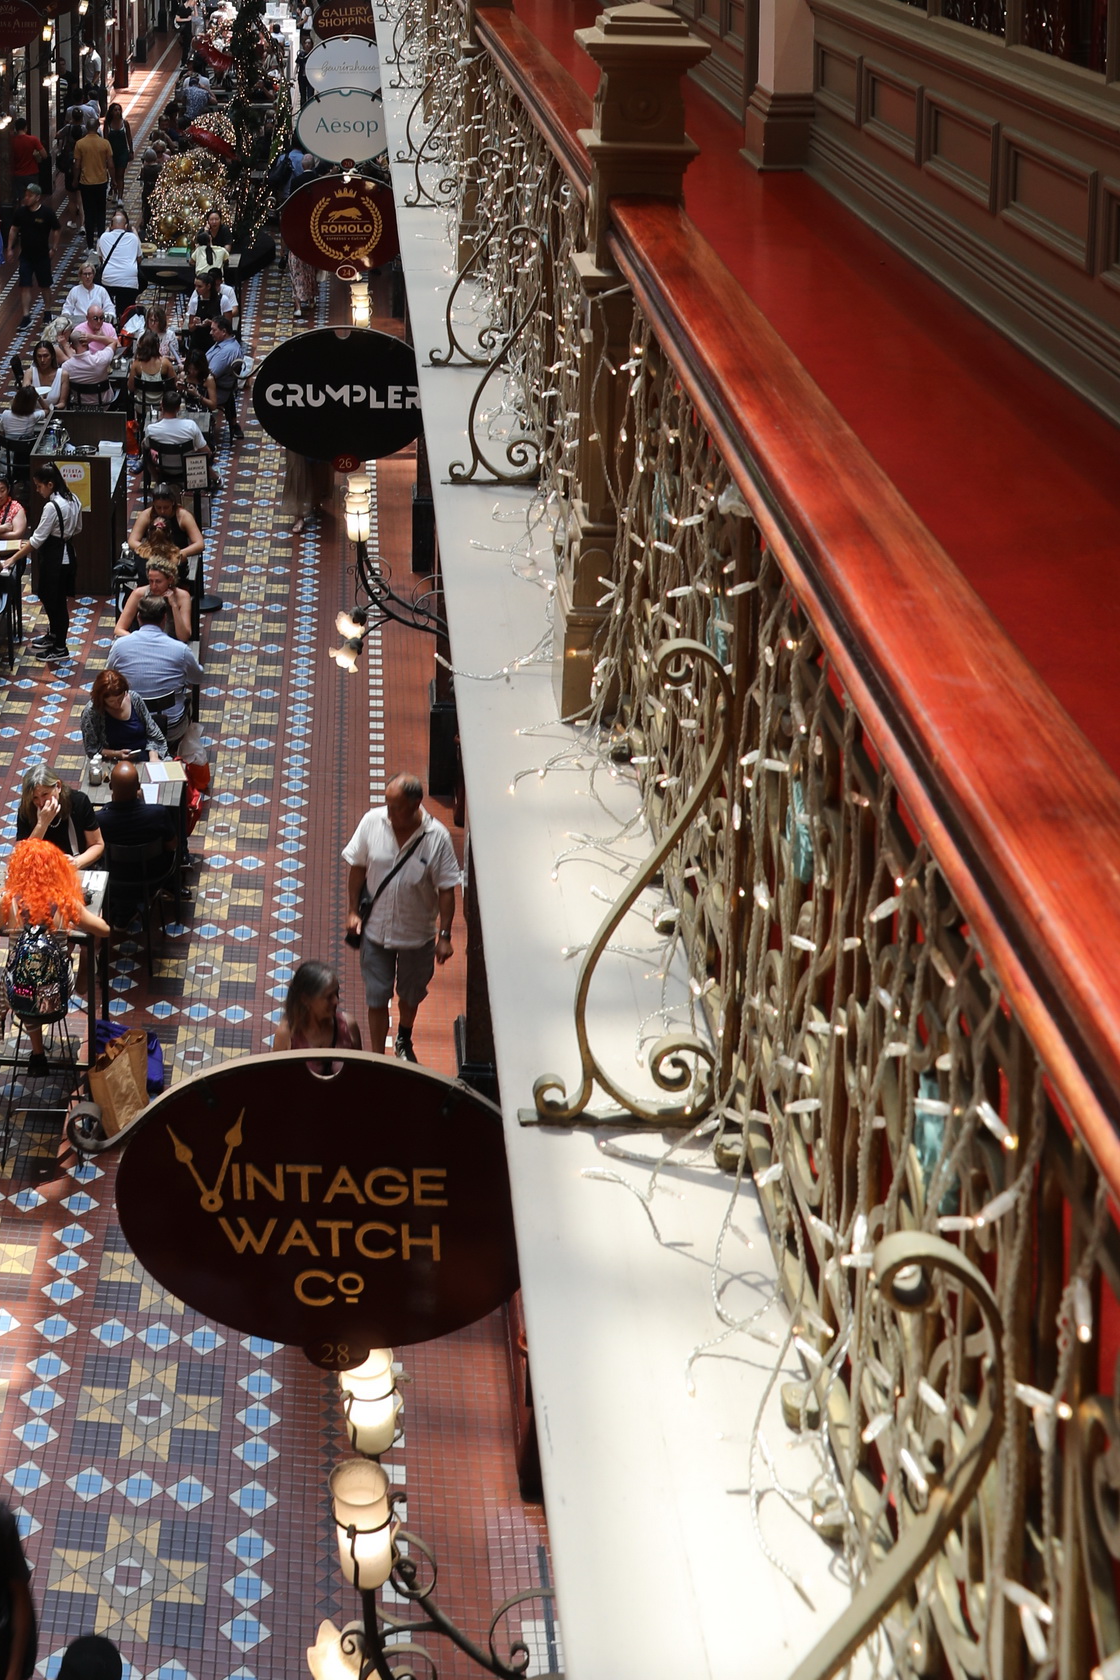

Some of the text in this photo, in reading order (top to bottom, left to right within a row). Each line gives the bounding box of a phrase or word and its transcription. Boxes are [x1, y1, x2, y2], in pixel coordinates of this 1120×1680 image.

[322, 6, 370, 17] GALLERY
[318, 16, 374, 28] SHOPPING
[321, 224, 372, 234] ROMOLO
[265, 382, 422, 410] CRUMPLER
[338, 458, 352, 469] 26
[166, 1107, 448, 1212] VINTAGE
[218, 1217, 441, 1262] WATCH
[320, 1343, 350, 1363] 28
